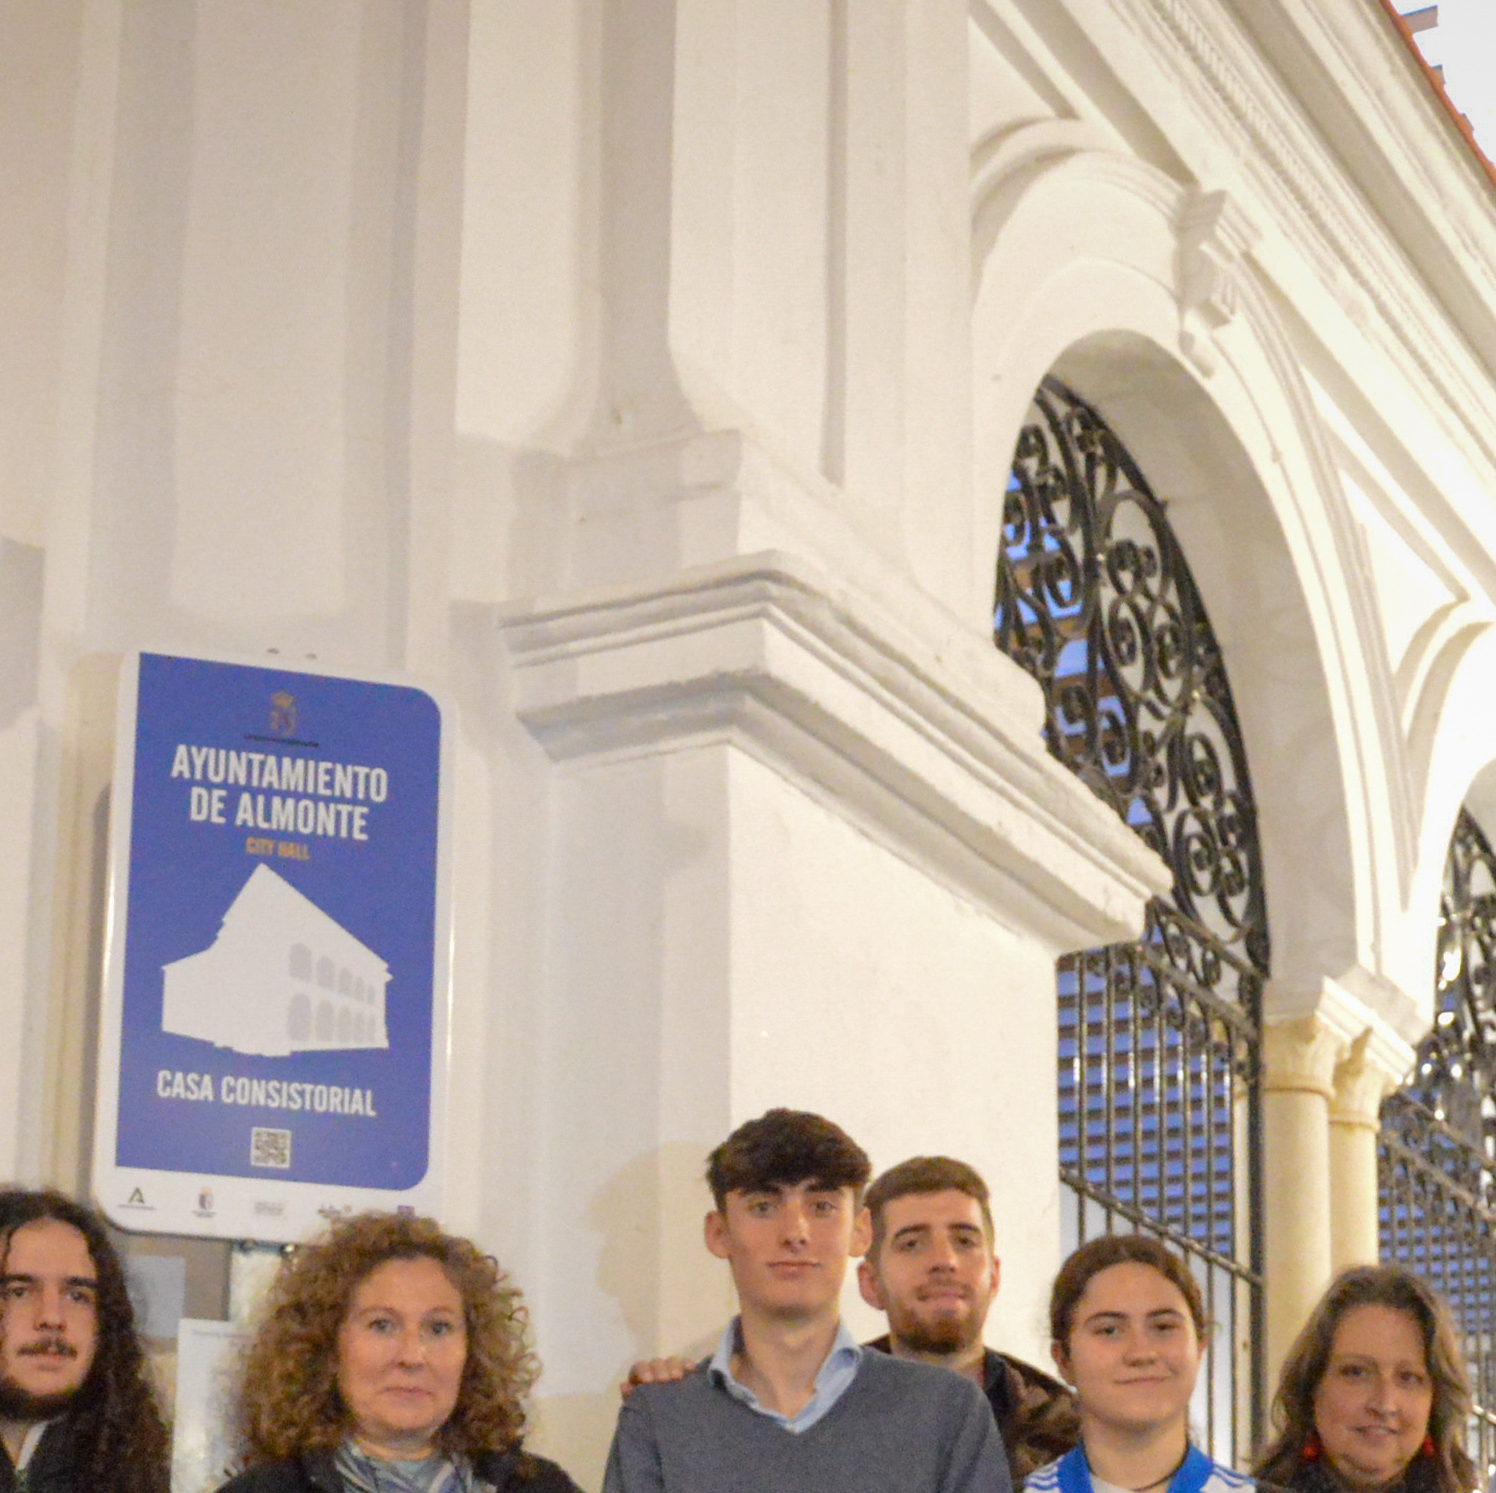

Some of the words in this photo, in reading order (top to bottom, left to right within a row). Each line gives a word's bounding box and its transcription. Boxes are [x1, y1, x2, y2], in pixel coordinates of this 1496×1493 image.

[171, 744, 389, 803] AYUNTAMIENTO
[190, 786, 227, 824] DE
[235, 792, 370, 841] ALMONTE
[156, 1069, 214, 1102] CASA
[221, 1075, 378, 1118] CONSISTORIAL
